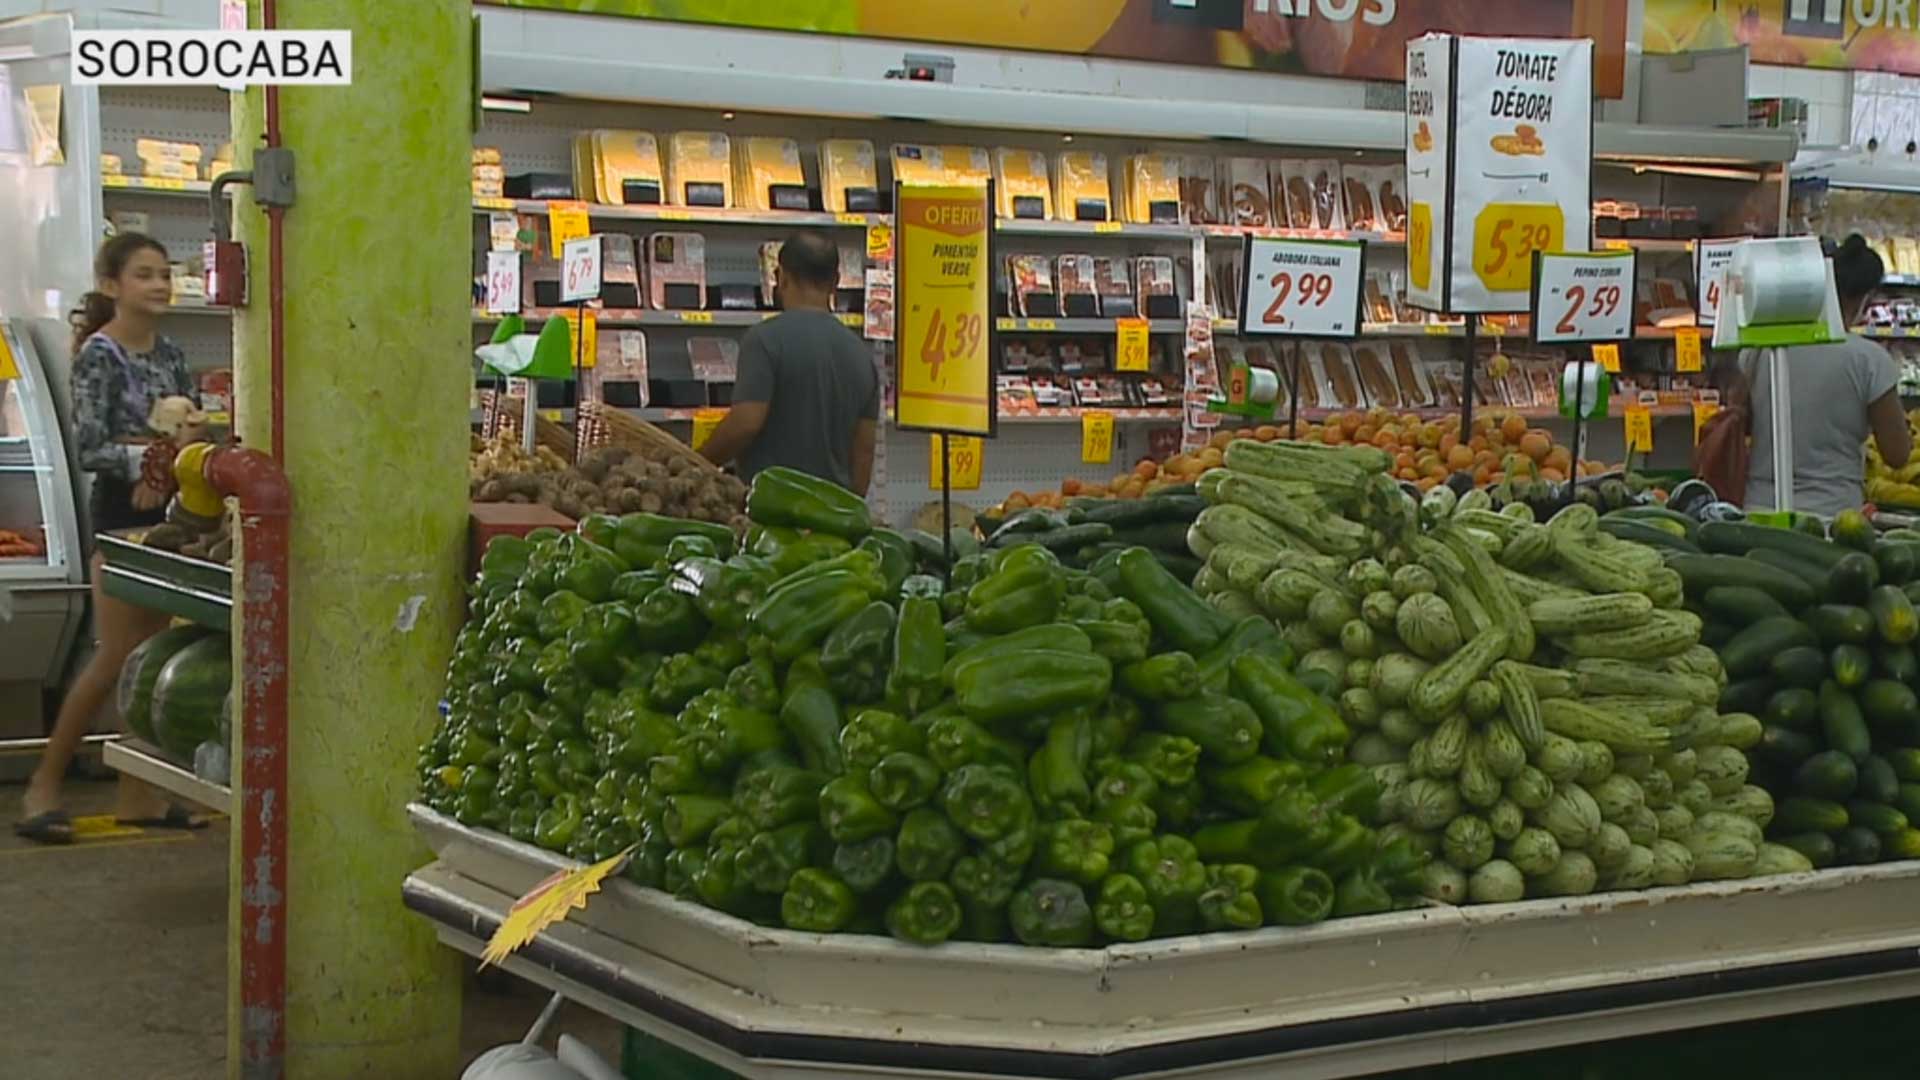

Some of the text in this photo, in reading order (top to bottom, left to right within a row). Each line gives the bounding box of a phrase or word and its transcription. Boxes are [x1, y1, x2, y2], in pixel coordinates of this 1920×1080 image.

[1495, 50, 1558, 82] TOMATE
[1490, 85, 1553, 123] DÉBORA
[942, 261, 970, 276] VERDE
